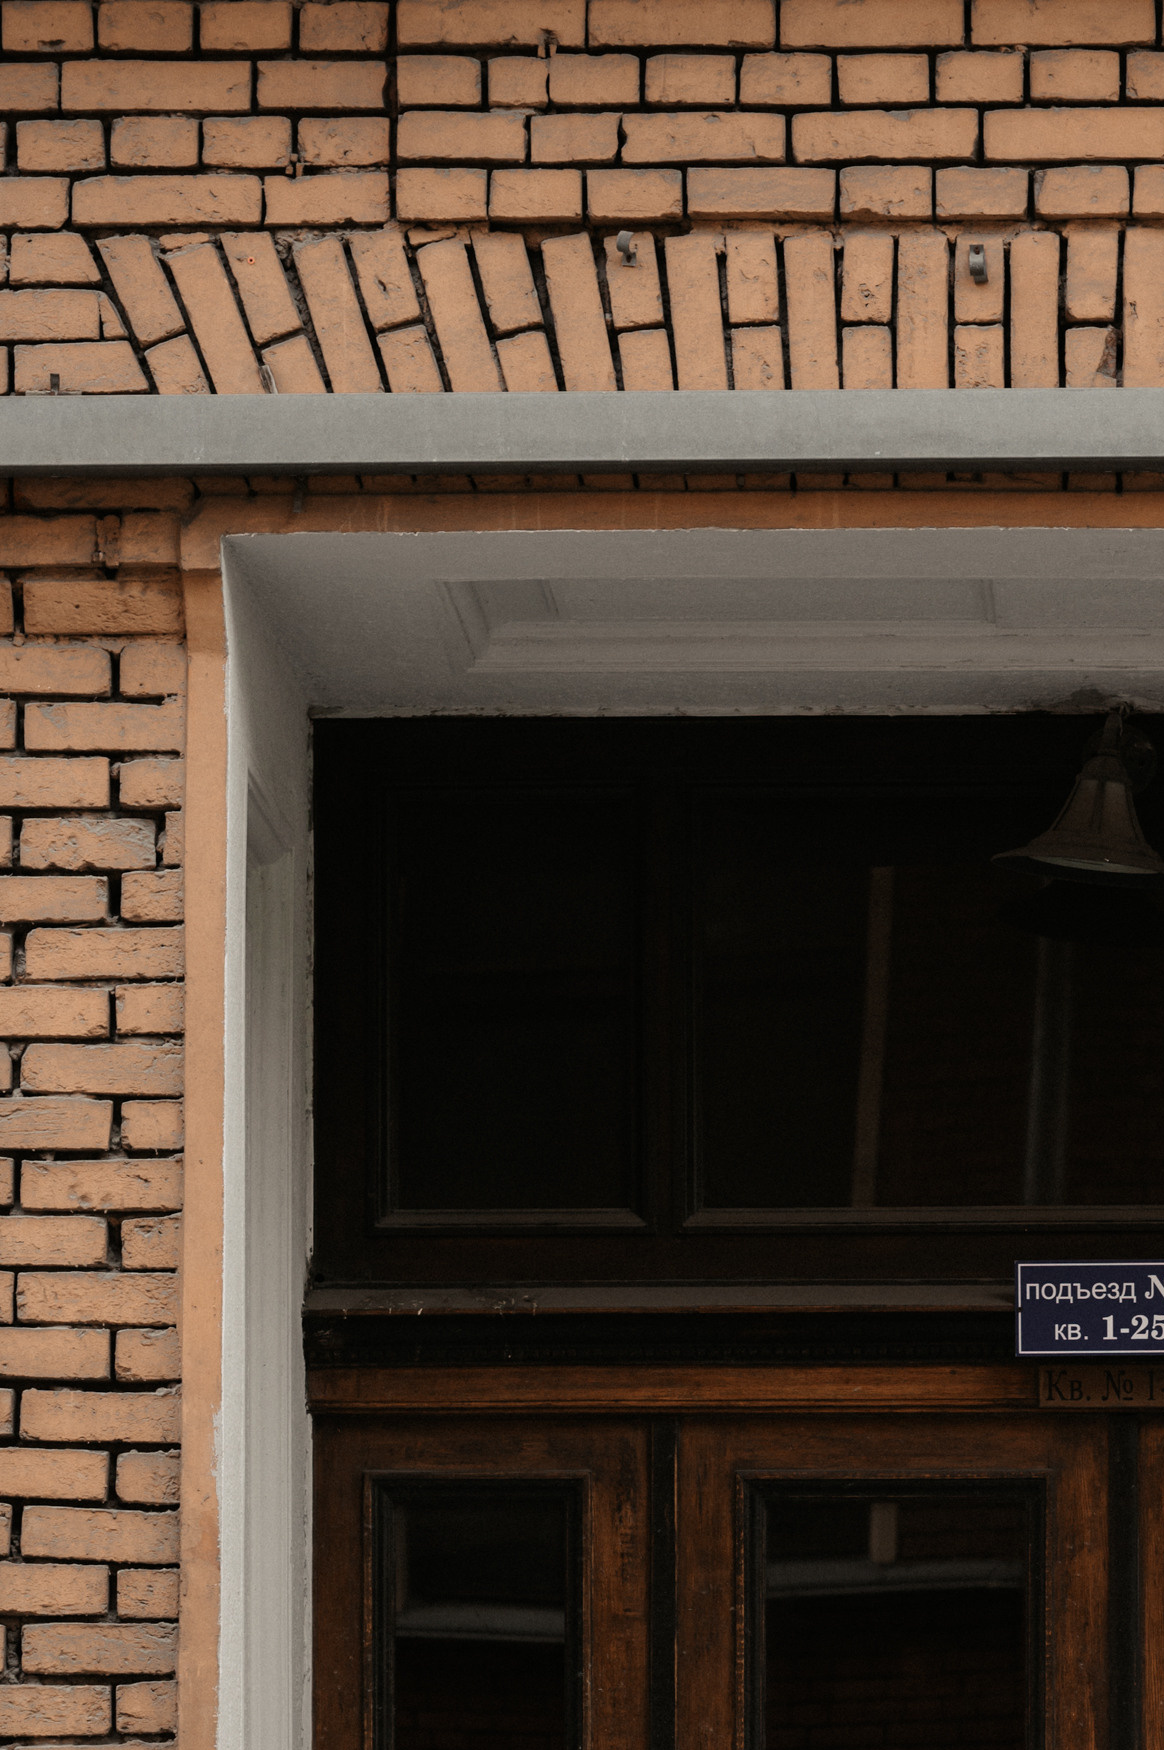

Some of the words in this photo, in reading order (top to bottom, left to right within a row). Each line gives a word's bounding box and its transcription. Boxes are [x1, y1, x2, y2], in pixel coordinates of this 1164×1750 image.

[1025, 1282, 1137, 1304] подъезд
[1054, 1323, 1089, 1341] кв.
[1045, 1369, 1091, 1401] Кв.
